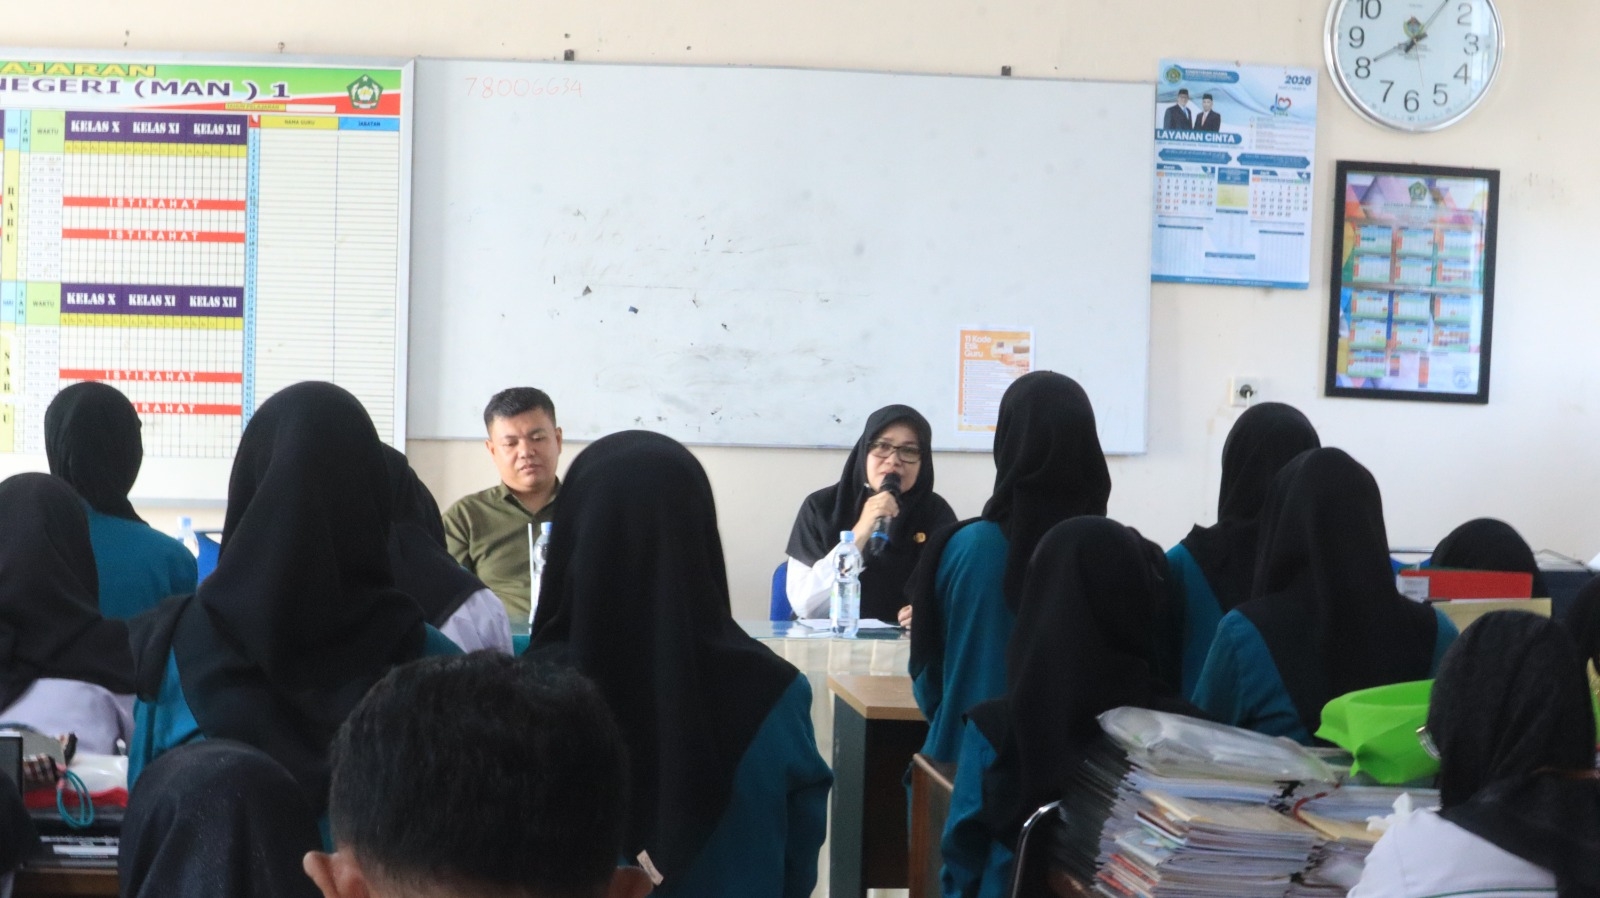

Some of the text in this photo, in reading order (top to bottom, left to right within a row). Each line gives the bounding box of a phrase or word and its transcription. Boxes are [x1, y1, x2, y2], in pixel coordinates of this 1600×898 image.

[1356, 0, 1382, 19] 10
[1457, 3, 1472, 26] 2
[1349, 26, 1365, 49] 9
[1464, 33, 1479, 56] 3
[1355, 56, 1371, 79] 8
[1453, 63, 1471, 85] 4
[1285, 75, 1312, 86] 2026
[272, 83, 290, 98] 1
[1380, 80, 1394, 103] 7
[1433, 83, 1448, 106] 5
[1403, 90, 1420, 113] 6
[71, 119, 241, 136] KELAS X KELAS XI KELAS XII
[1157, 130, 1203, 143] LAYANAN
[1205, 133, 1235, 145] CINTA
[109, 198, 200, 209] ISTIRAHAT
[108, 230, 199, 241] ISTIRAHAT
[66, 292, 237, 308] KELAS X KELAS XI KELAS XII
[105, 370, 196, 382] ISTIRAHAT
[134, 404, 196, 414] IRAHAT
